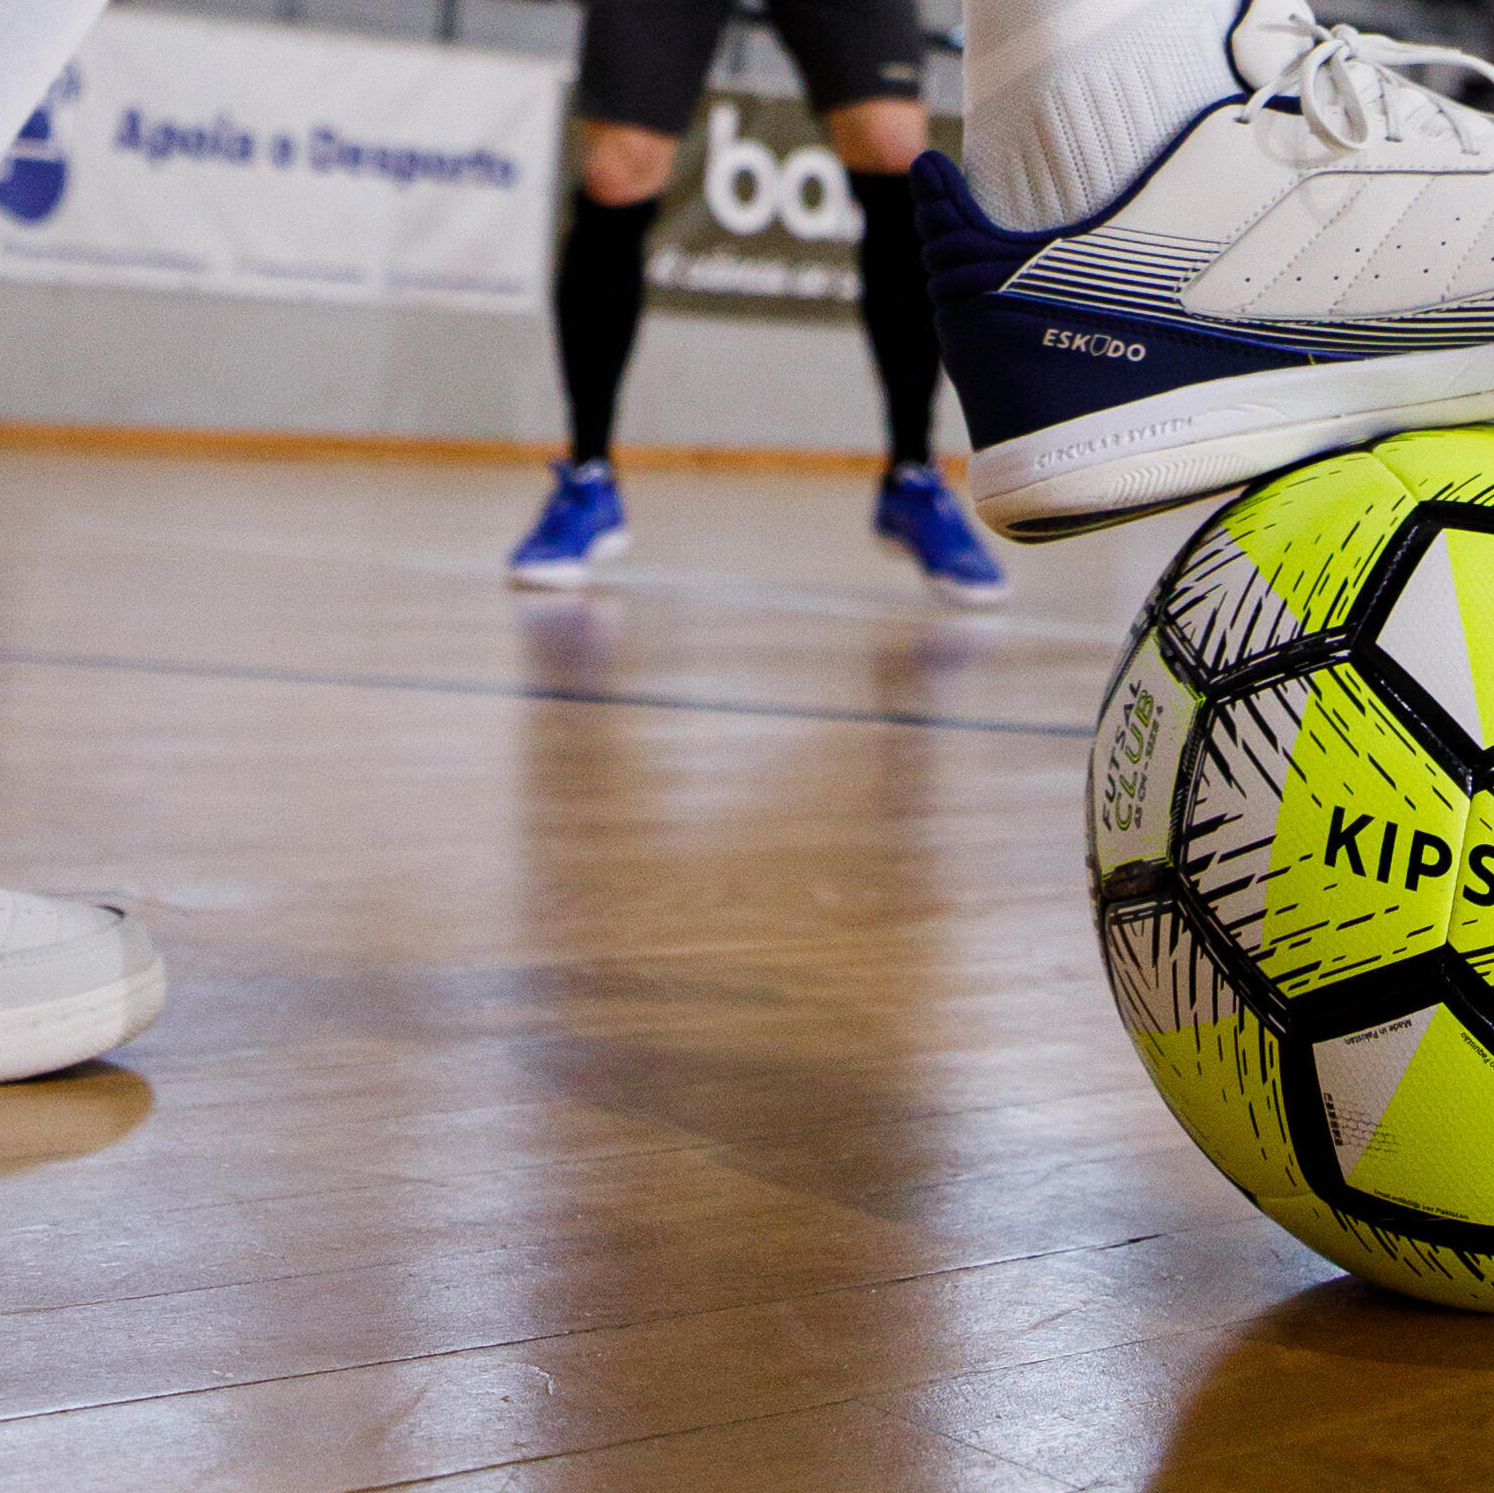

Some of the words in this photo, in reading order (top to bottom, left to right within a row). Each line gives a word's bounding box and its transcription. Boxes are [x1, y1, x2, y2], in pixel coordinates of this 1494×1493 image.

[1102, 679, 1142, 832] FUTSAL
[1115, 688, 1155, 832] CLUB
[1344, 1031, 1379, 1045] Pakistan
[1388, 1019, 1413, 1032] Made
